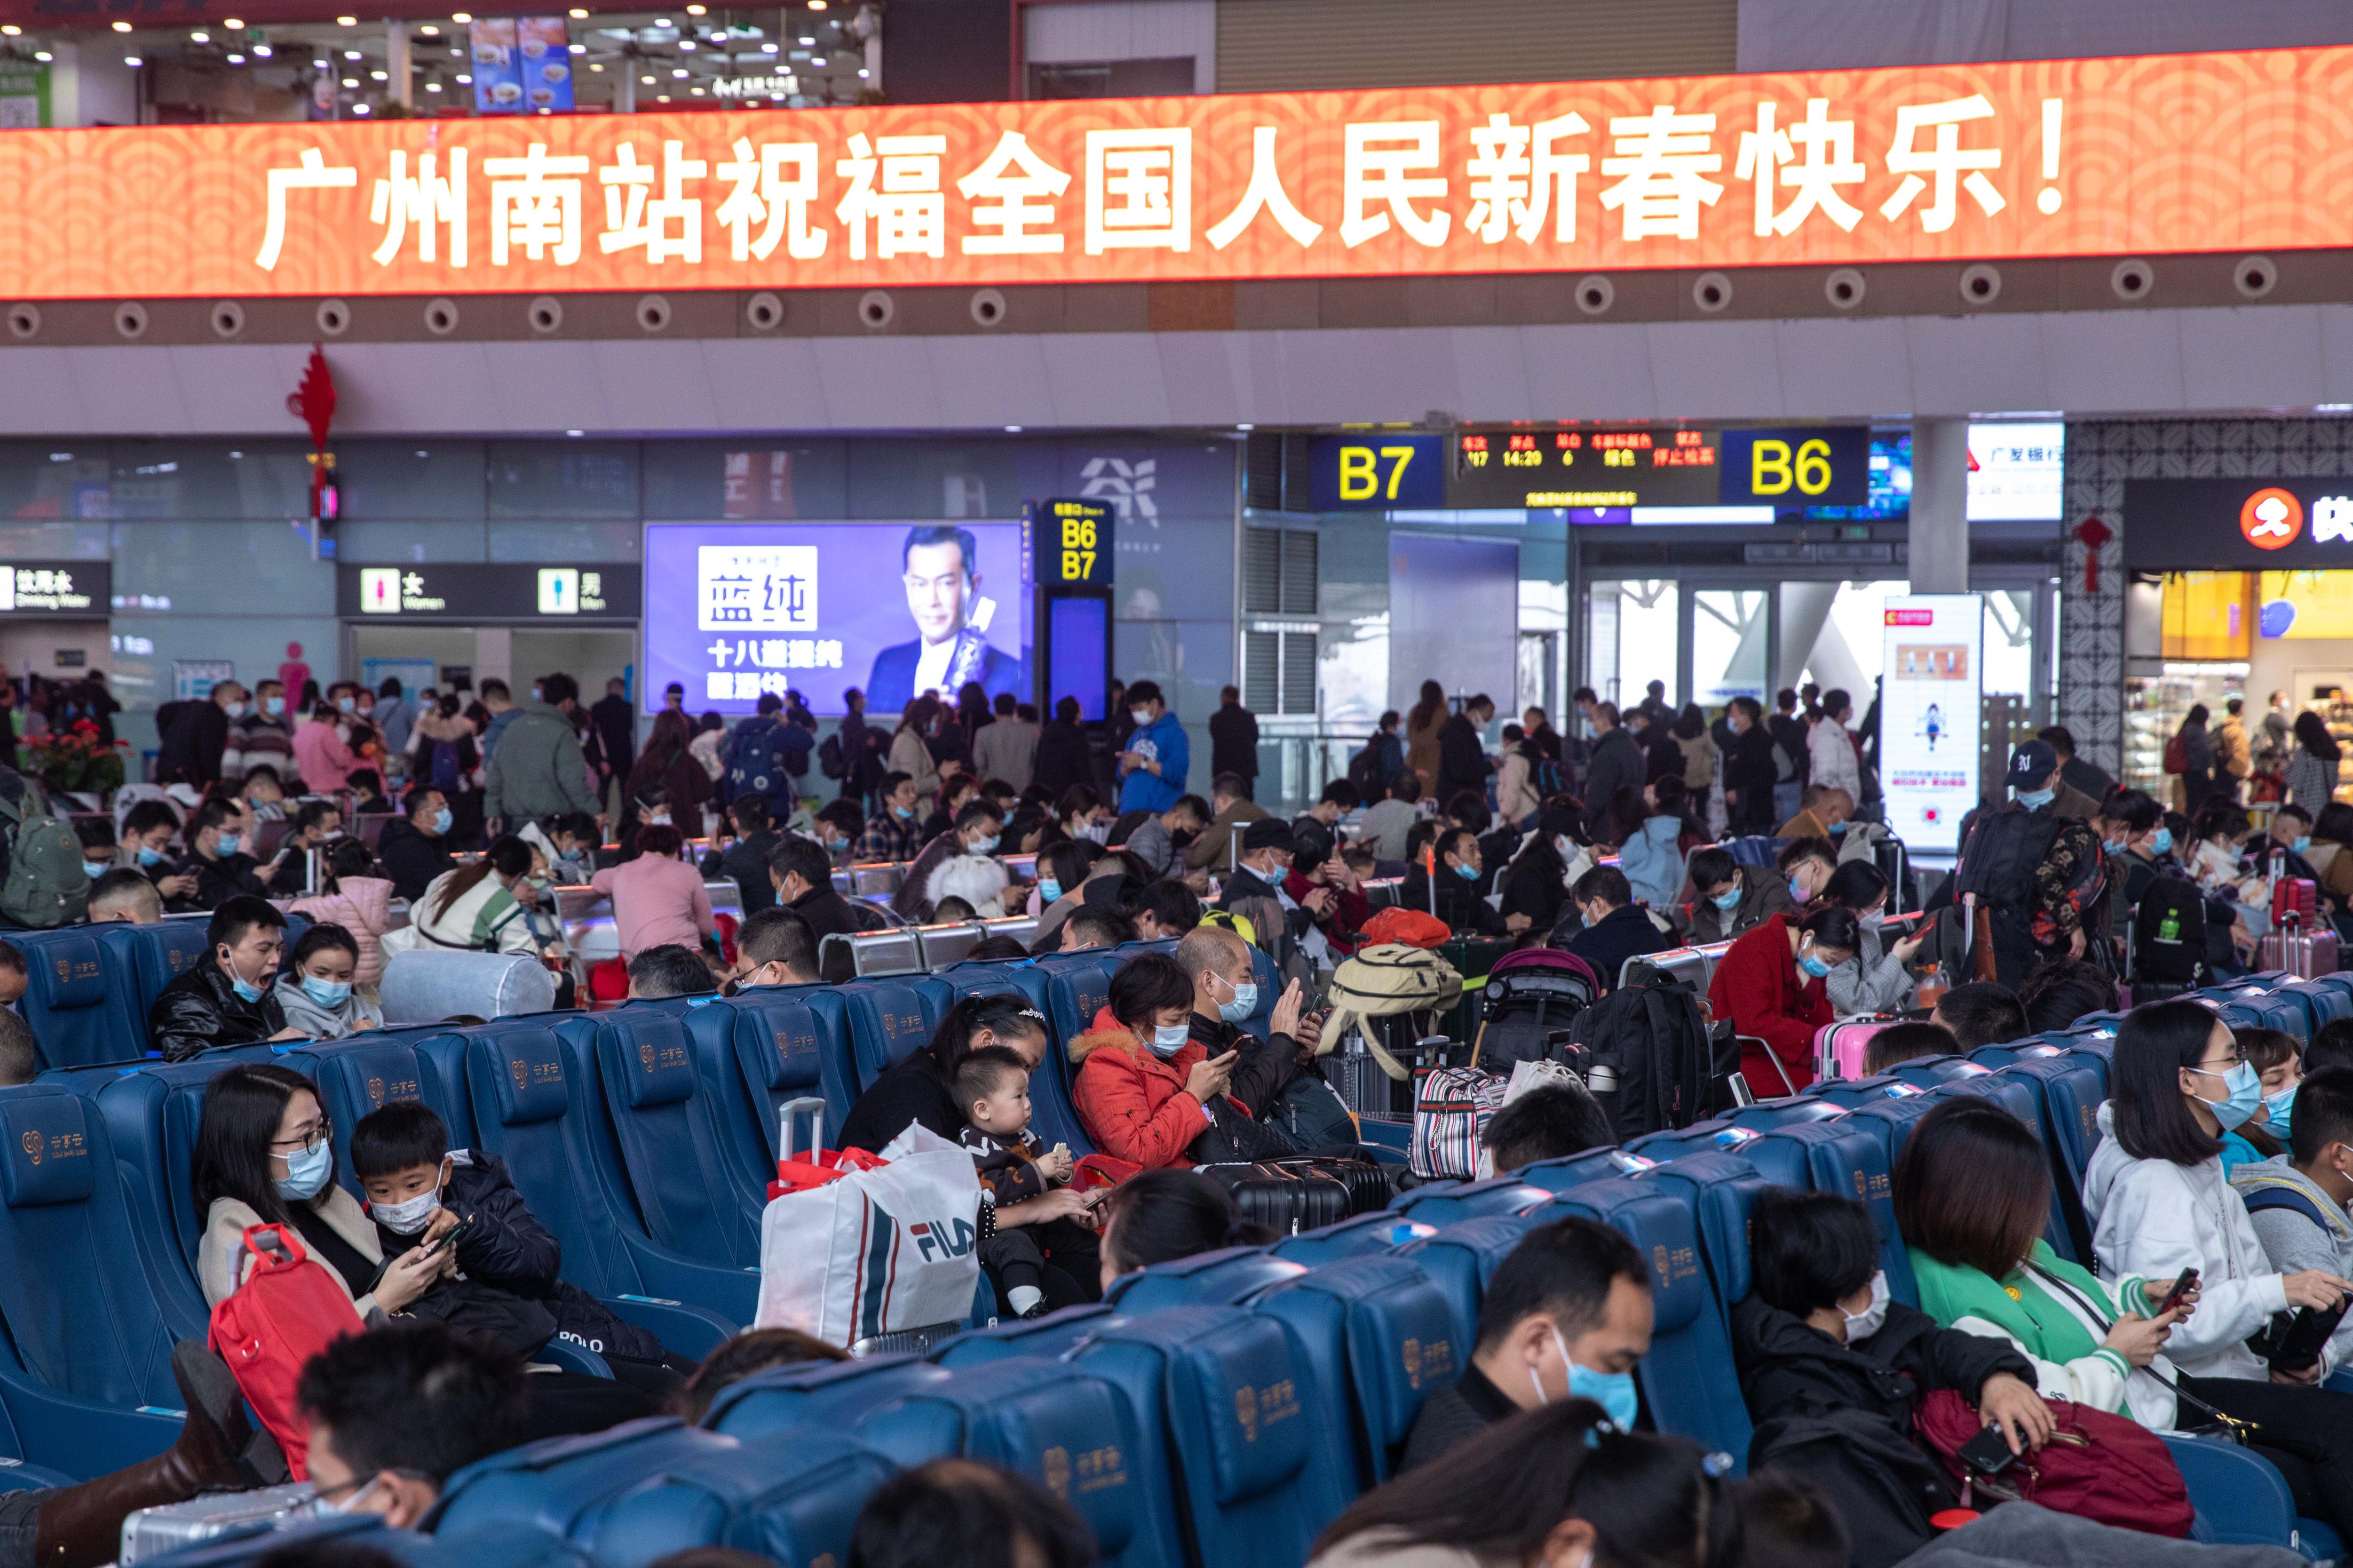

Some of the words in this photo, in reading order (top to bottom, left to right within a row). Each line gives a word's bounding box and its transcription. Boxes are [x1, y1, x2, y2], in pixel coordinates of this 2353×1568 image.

[257, 93, 2063, 271] 广州南站祝福全国人民新春快乐！
[1340, 446, 1415, 500] B7
[1503, 450, 1542, 467] 14:20
[1562, 450, 1574, 466] 6
[1752, 439, 1832, 495] B6
[1062, 519, 1097, 550] B6
[1062, 550, 1097, 580] B7
[401, 571, 424, 595] 女
[580, 572, 600, 596] 男
[711, 574, 805, 622] 蓝纯
[533, 1062, 558, 1076] 云享云
[390, 1080, 416, 1094] 云享云
[51, 1133, 83, 1148] 云享云
[910, 1217, 975, 1263] FILA
